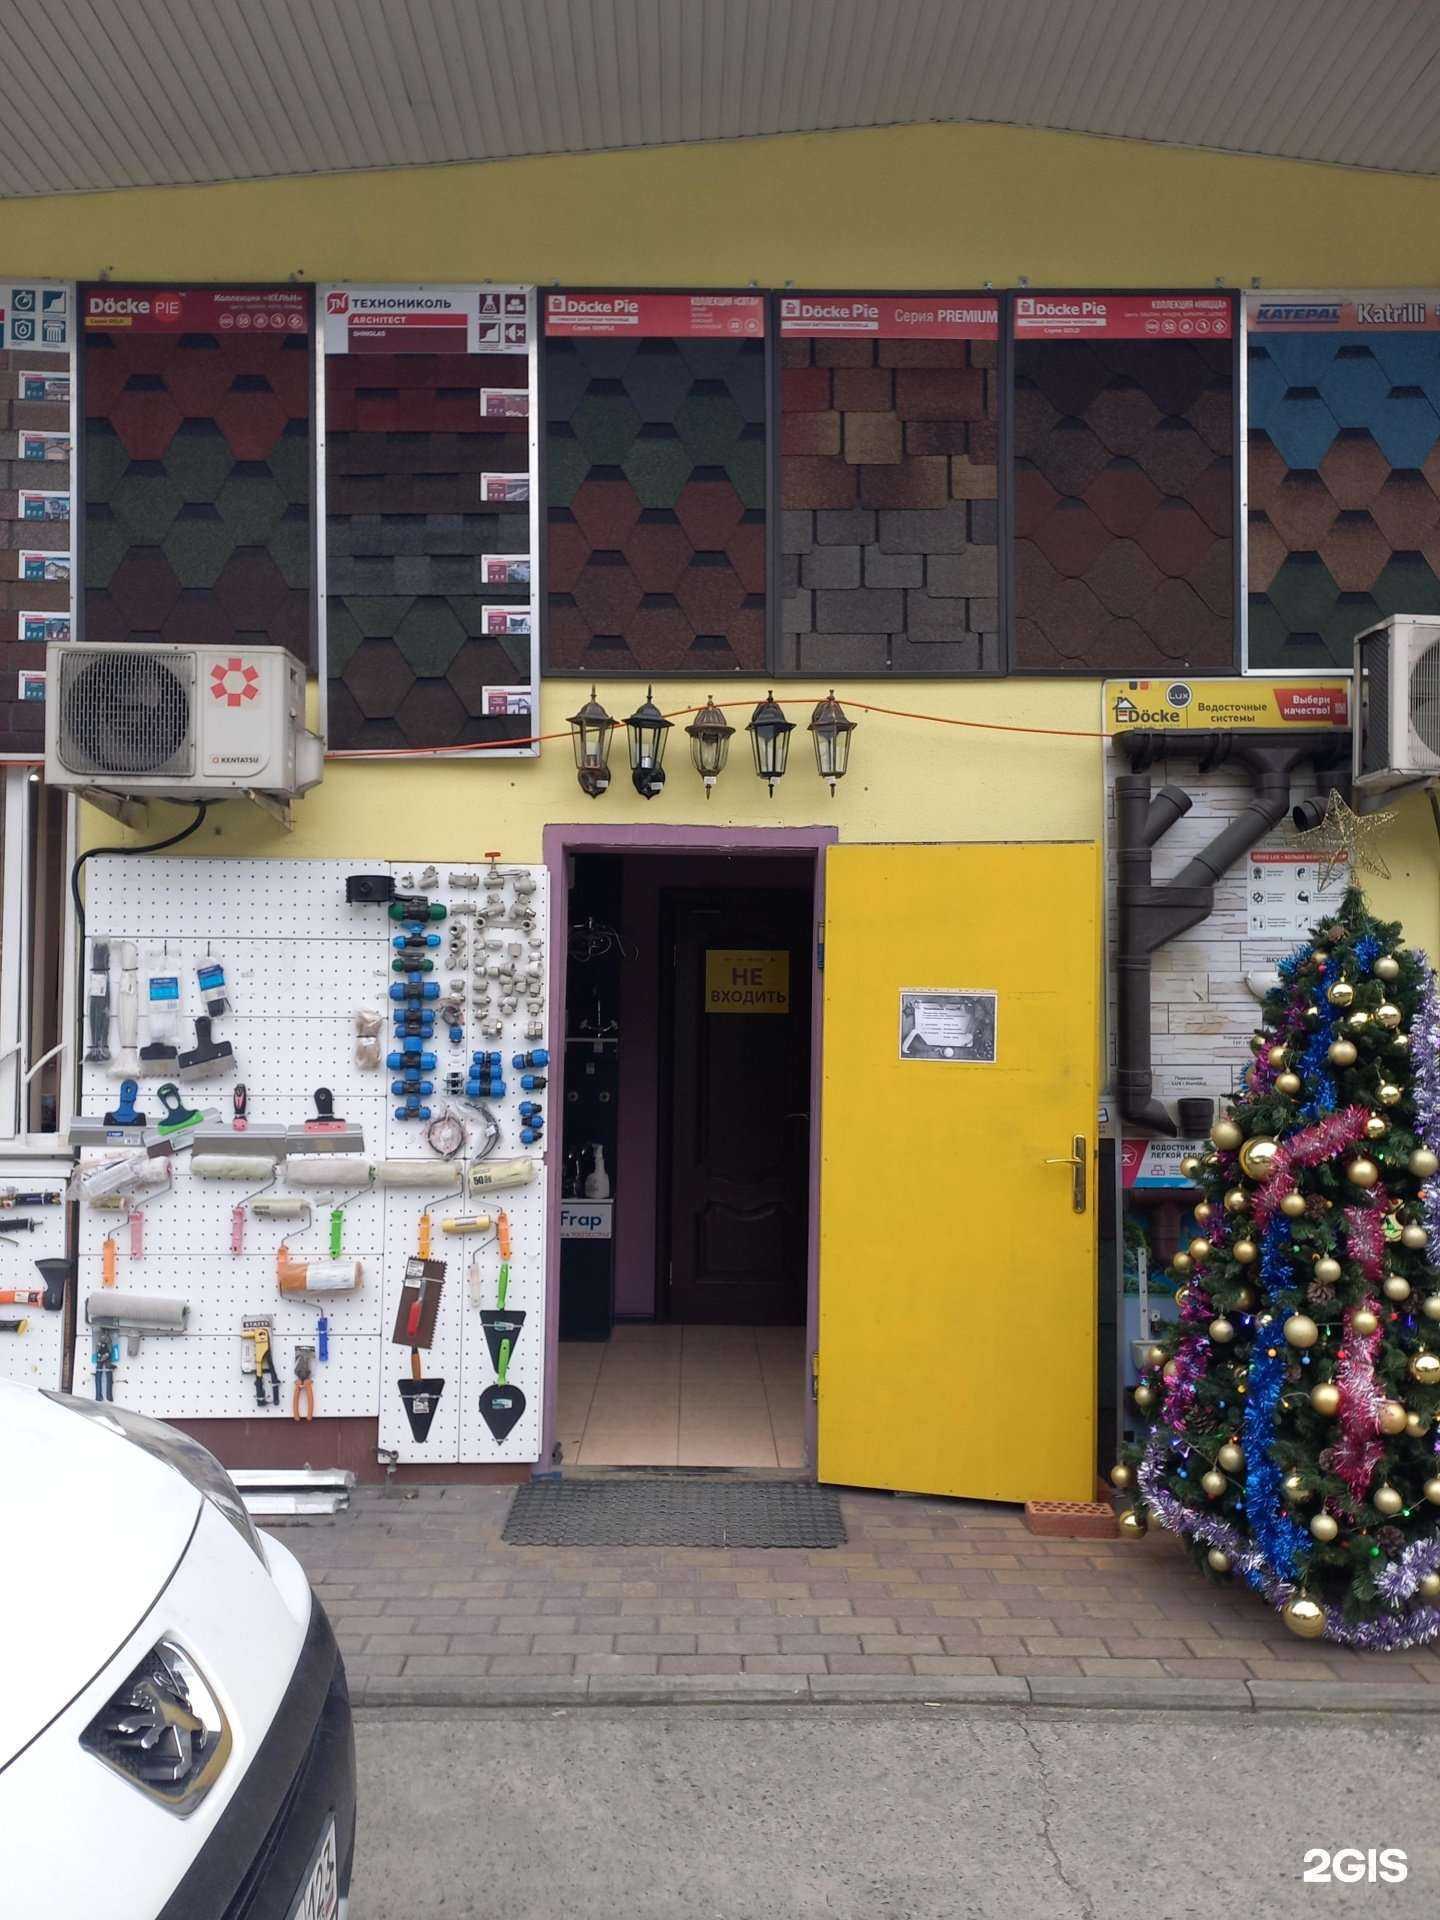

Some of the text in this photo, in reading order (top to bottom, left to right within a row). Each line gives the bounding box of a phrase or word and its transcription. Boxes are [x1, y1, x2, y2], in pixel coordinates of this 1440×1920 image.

[90, 297, 180, 314] Döcke PIE
[352, 298, 452, 309] ТЕХНОНИКОЛЬ
[567, 299, 639, 313] Döcke Pie
[802, 303, 879, 318] Döcke Pie
[1036, 301, 1079, 316] Döcke
[1082, 301, 1107, 316] Pie
[352, 316, 406, 324] ARCHITECT
[895, 308, 998, 323] Серия PREMIUM
[1257, 308, 1341, 321] KATEPAL
[1357, 302, 1426, 324] Katrilli
[1292, 694, 1331, 705] Выбери
[1197, 703, 1268, 714] Водосточные
[1283, 705, 1331, 716] качество!
[1129, 709, 1180, 723] Döcke
[1210, 714, 1256, 723] системы
[731, 967, 764, 986] НЕ
[711, 990, 786, 1005] ВХОДИТЬ
[1150, 1144, 1196, 1152] ВОДОСТОКИ
[560, 1210, 602, 1231] Frap
